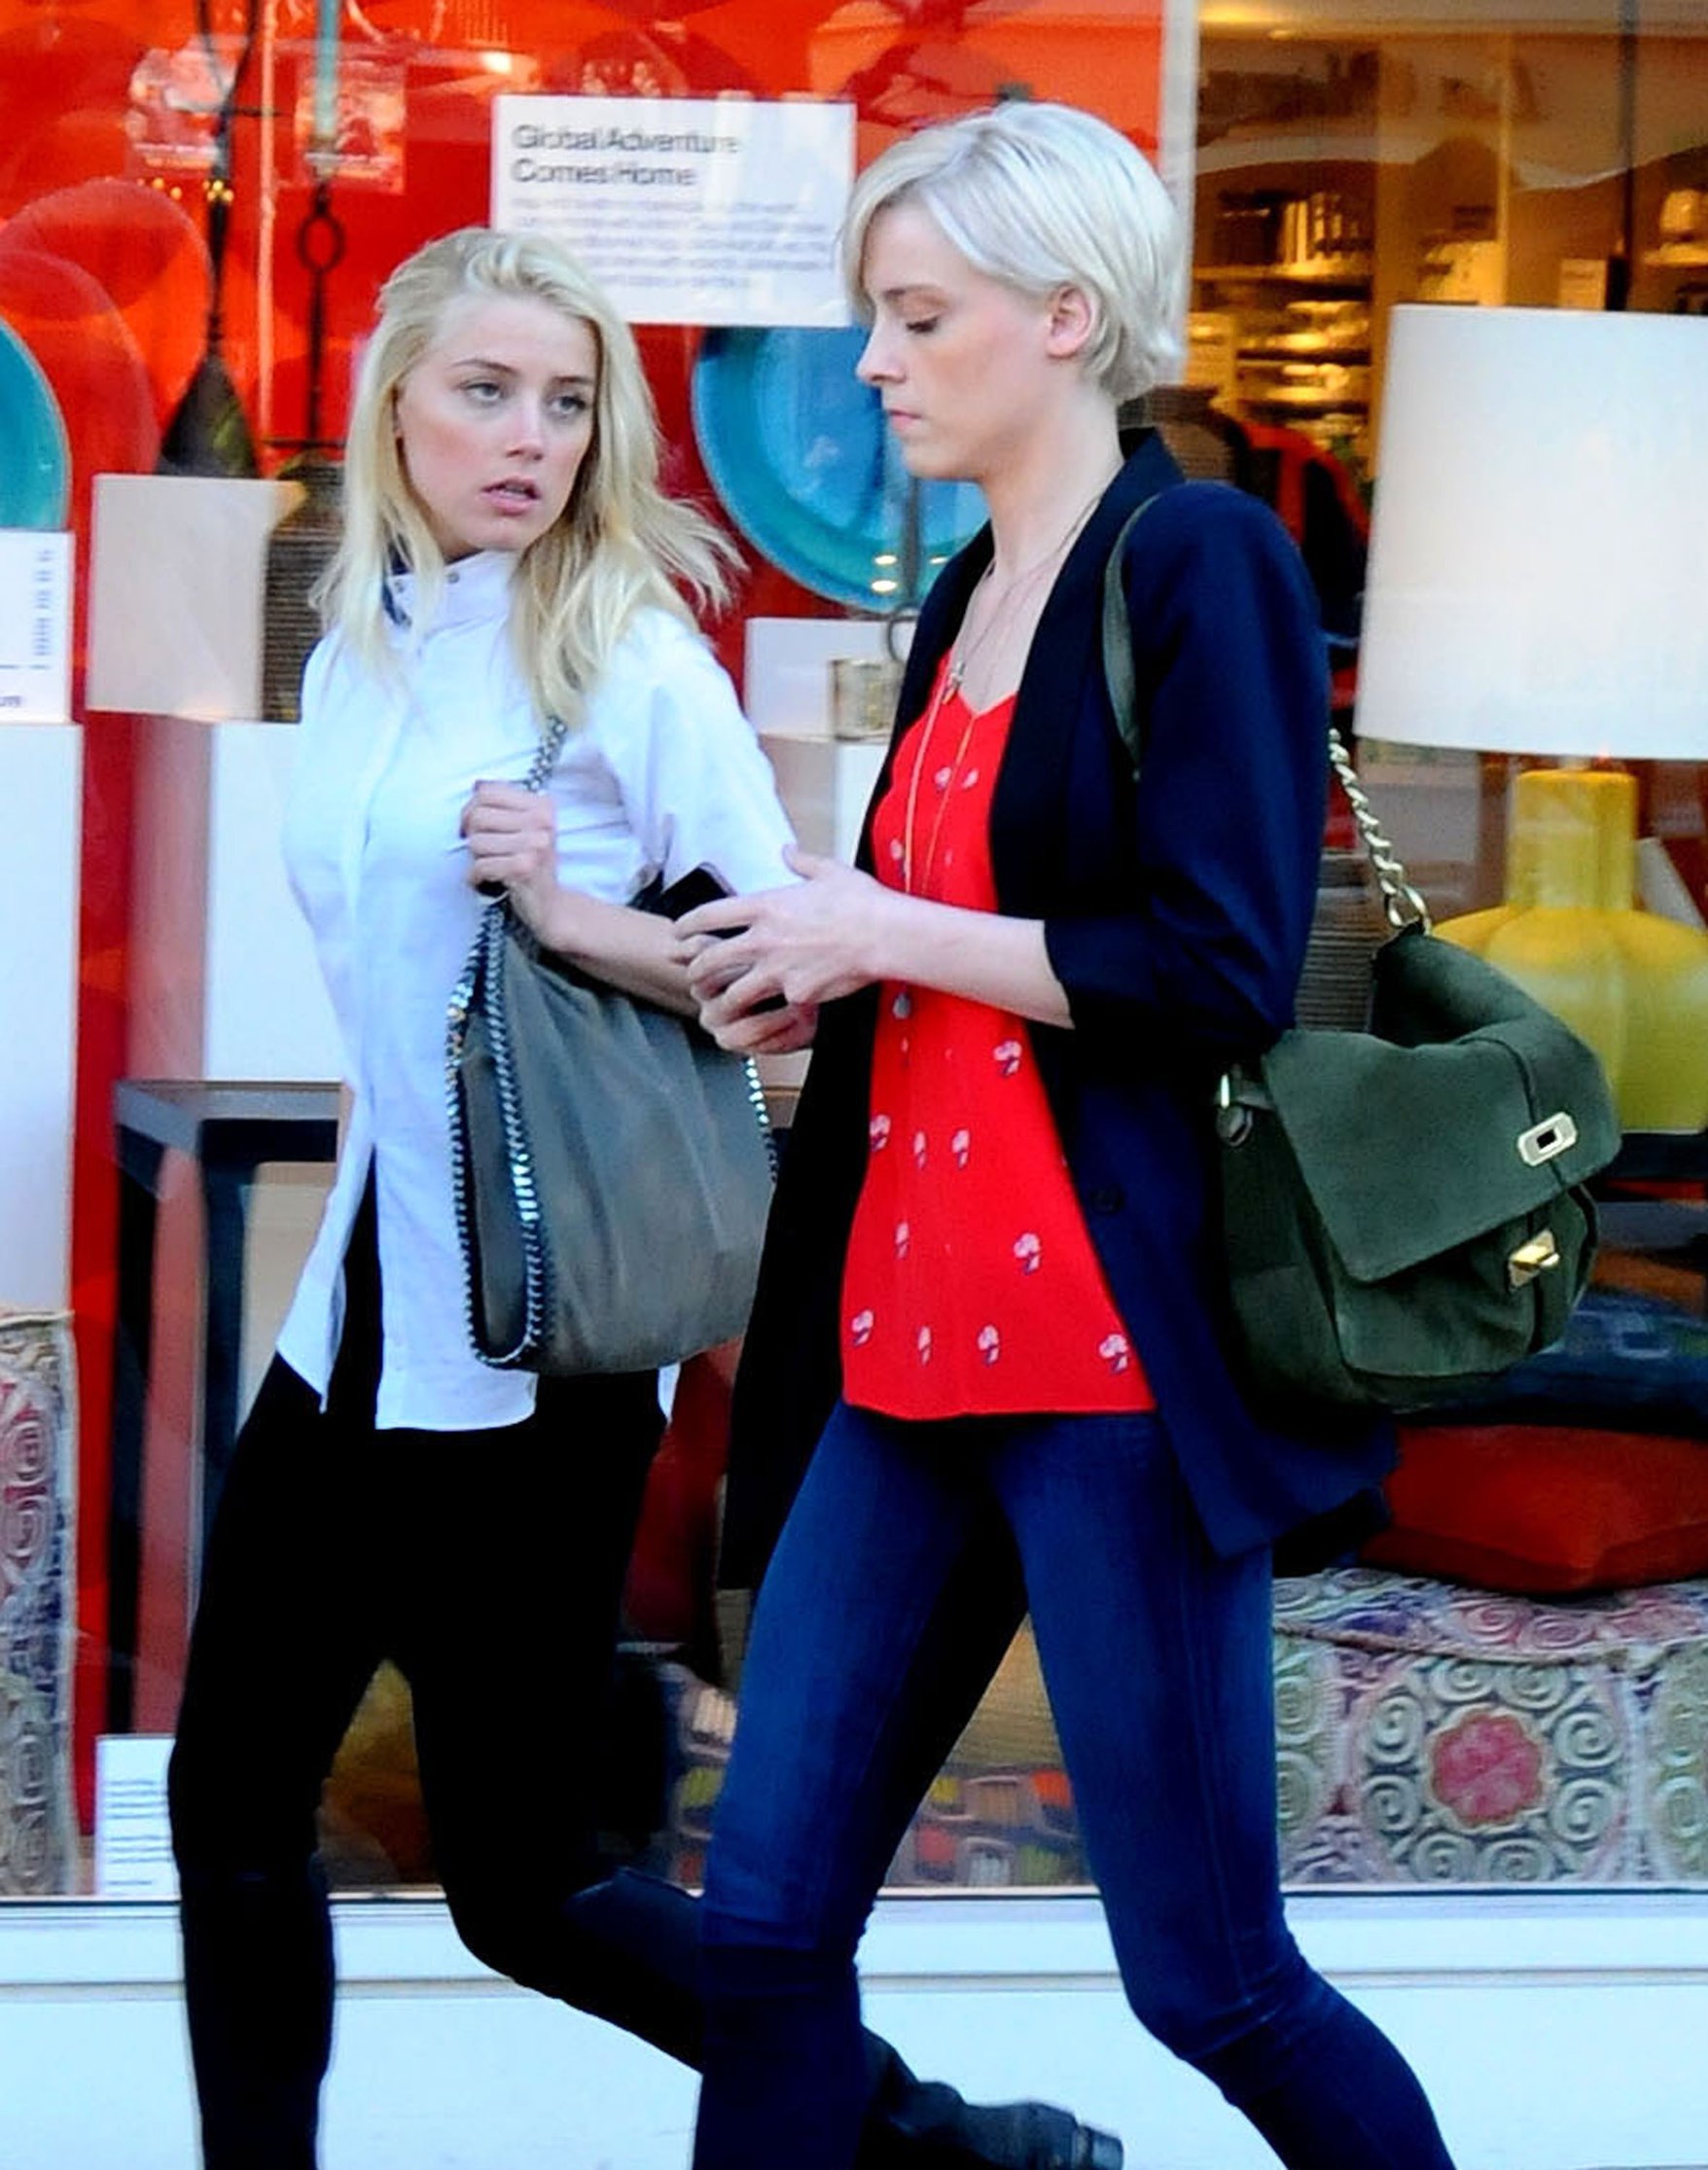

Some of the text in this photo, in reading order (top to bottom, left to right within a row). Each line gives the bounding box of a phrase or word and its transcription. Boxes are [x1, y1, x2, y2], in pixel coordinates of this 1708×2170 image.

[512, 125, 741, 154] Global Adventure
[511, 158, 695, 186] Comes Home
